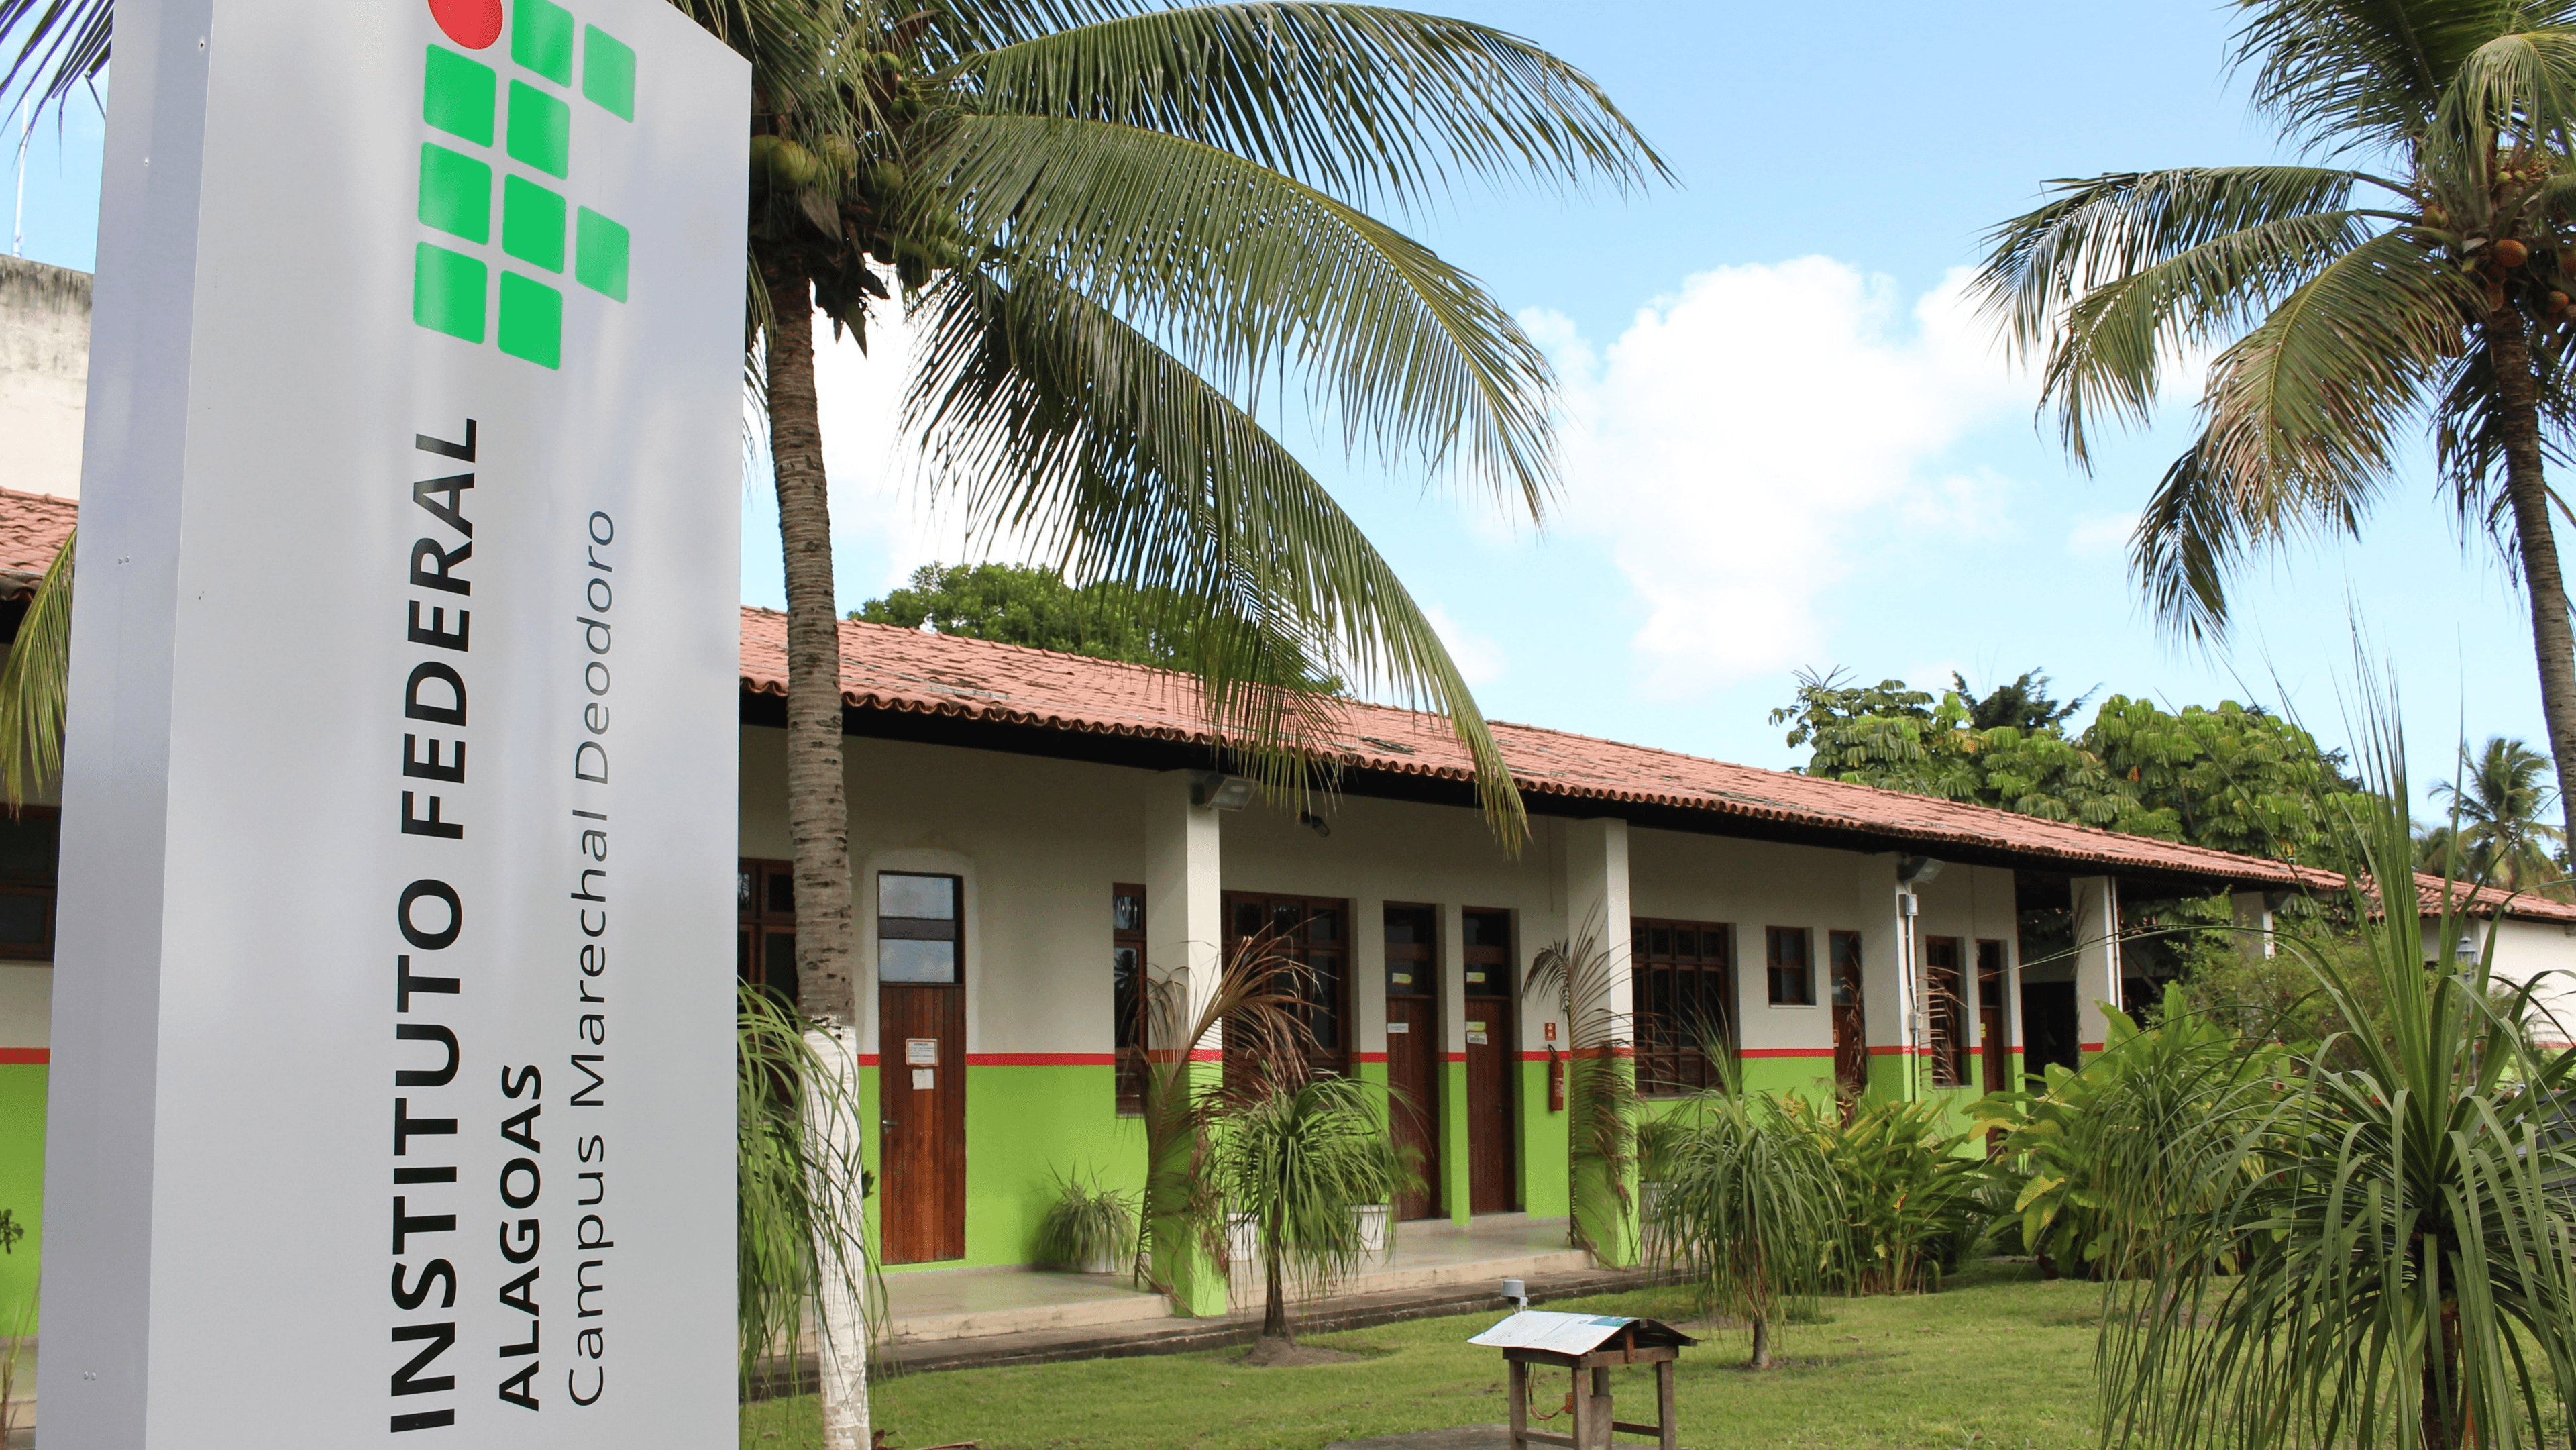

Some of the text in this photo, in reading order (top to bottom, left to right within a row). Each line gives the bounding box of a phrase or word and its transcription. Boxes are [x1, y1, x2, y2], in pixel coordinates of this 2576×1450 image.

[390, 418, 477, 1433] INSTITUTO FEDERAL
[498, 1064, 542, 1412] ALAGOAS
[568, 511, 614, 1406] Campus Marechal Deodoro
